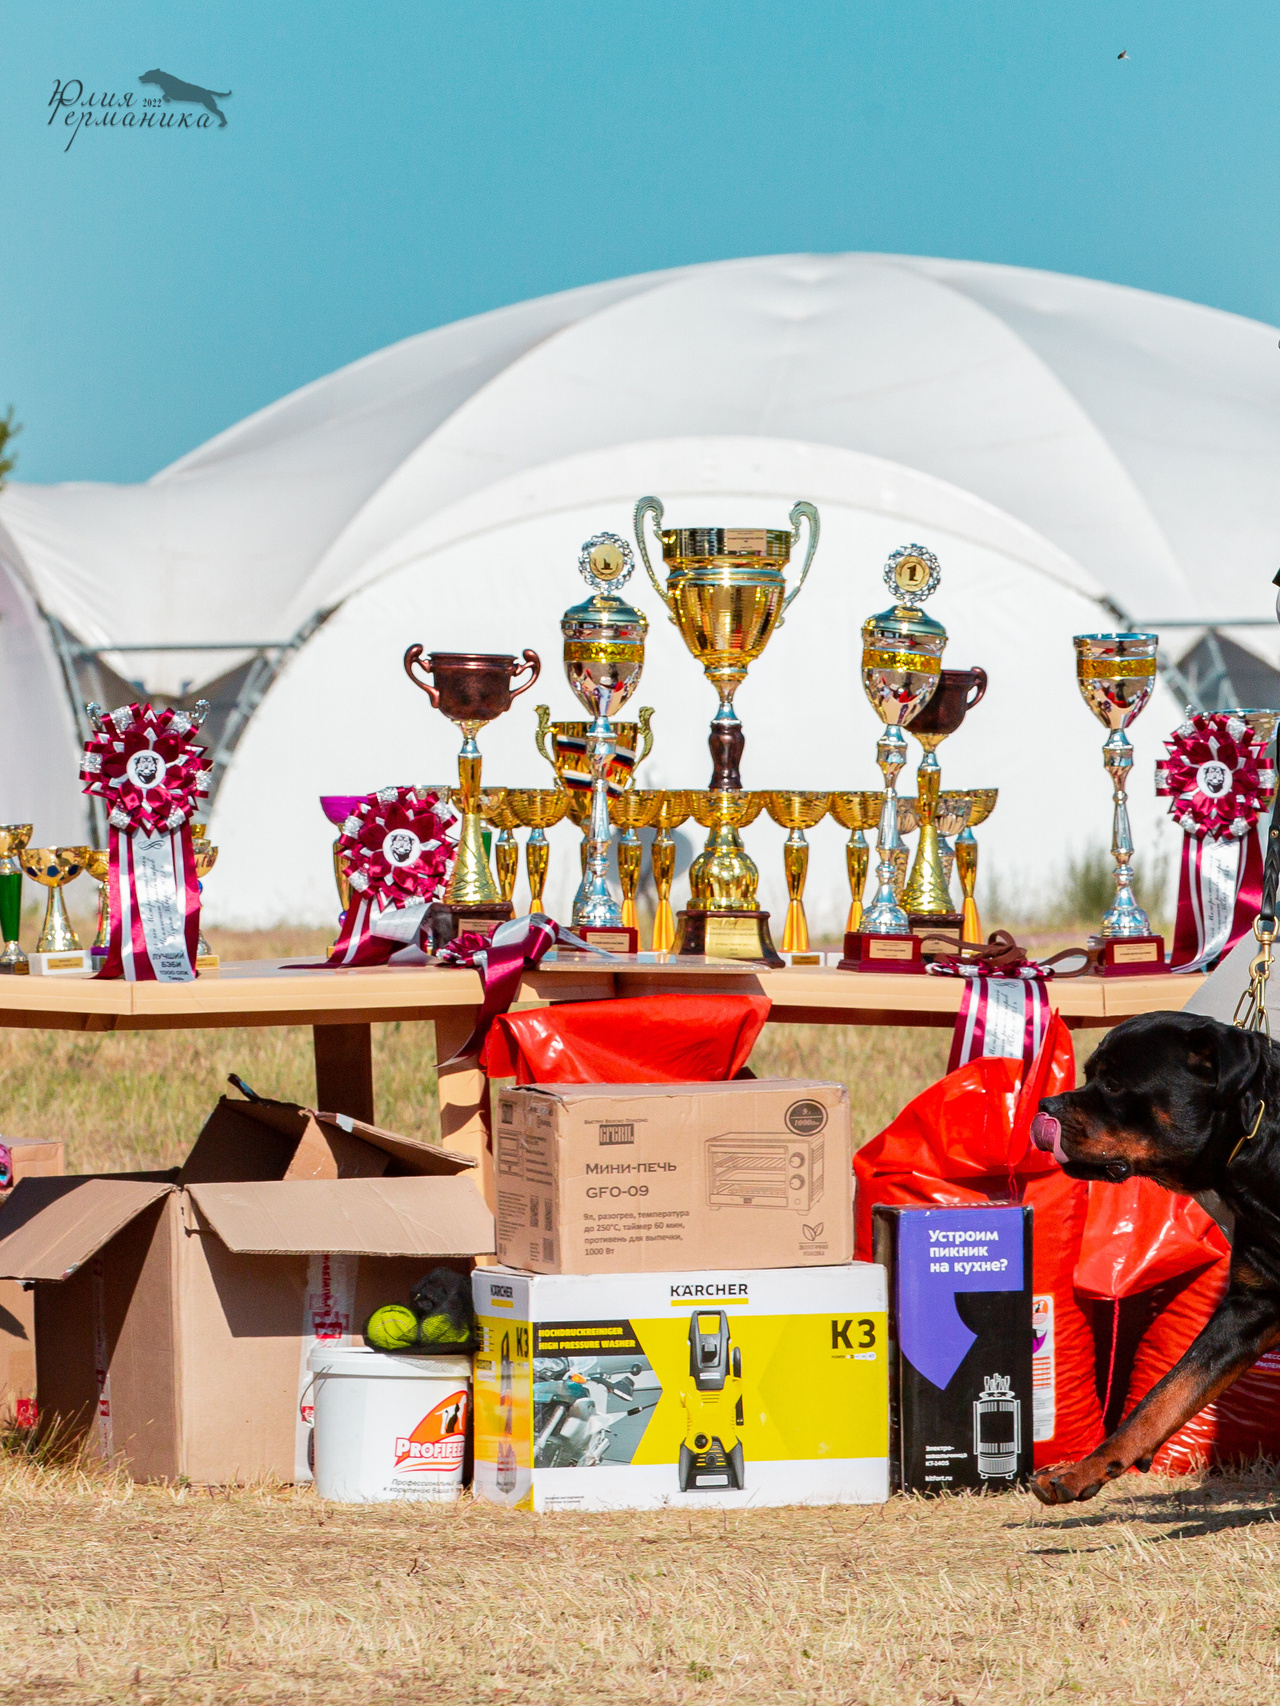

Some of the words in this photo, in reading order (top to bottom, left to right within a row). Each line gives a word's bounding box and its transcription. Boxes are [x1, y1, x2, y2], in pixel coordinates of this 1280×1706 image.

[153, 950, 184, 960] ЛУЧШИЙ
[586, 1185, 649, 1198] GFO-09
[638, 1210, 690, 1219] температура
[623, 1222, 652, 1231] таймер
[654, 1221, 664, 1229] 60
[928, 1230, 999, 1244] Устроим
[584, 1248, 604, 1256] 1000
[930, 1246, 988, 1257] пикник
[930, 1262, 950, 1272] на
[954, 1258, 1008, 1275] кухне?
[670, 1283, 748, 1297] KÄRCHER
[539, 1327, 623, 1338] HOCHDRUCKREINIGER
[539, 1342, 559, 1350] HIGH
[560, 1341, 600, 1349] PRESSURE
[601, 1339, 636, 1348] WASHER
